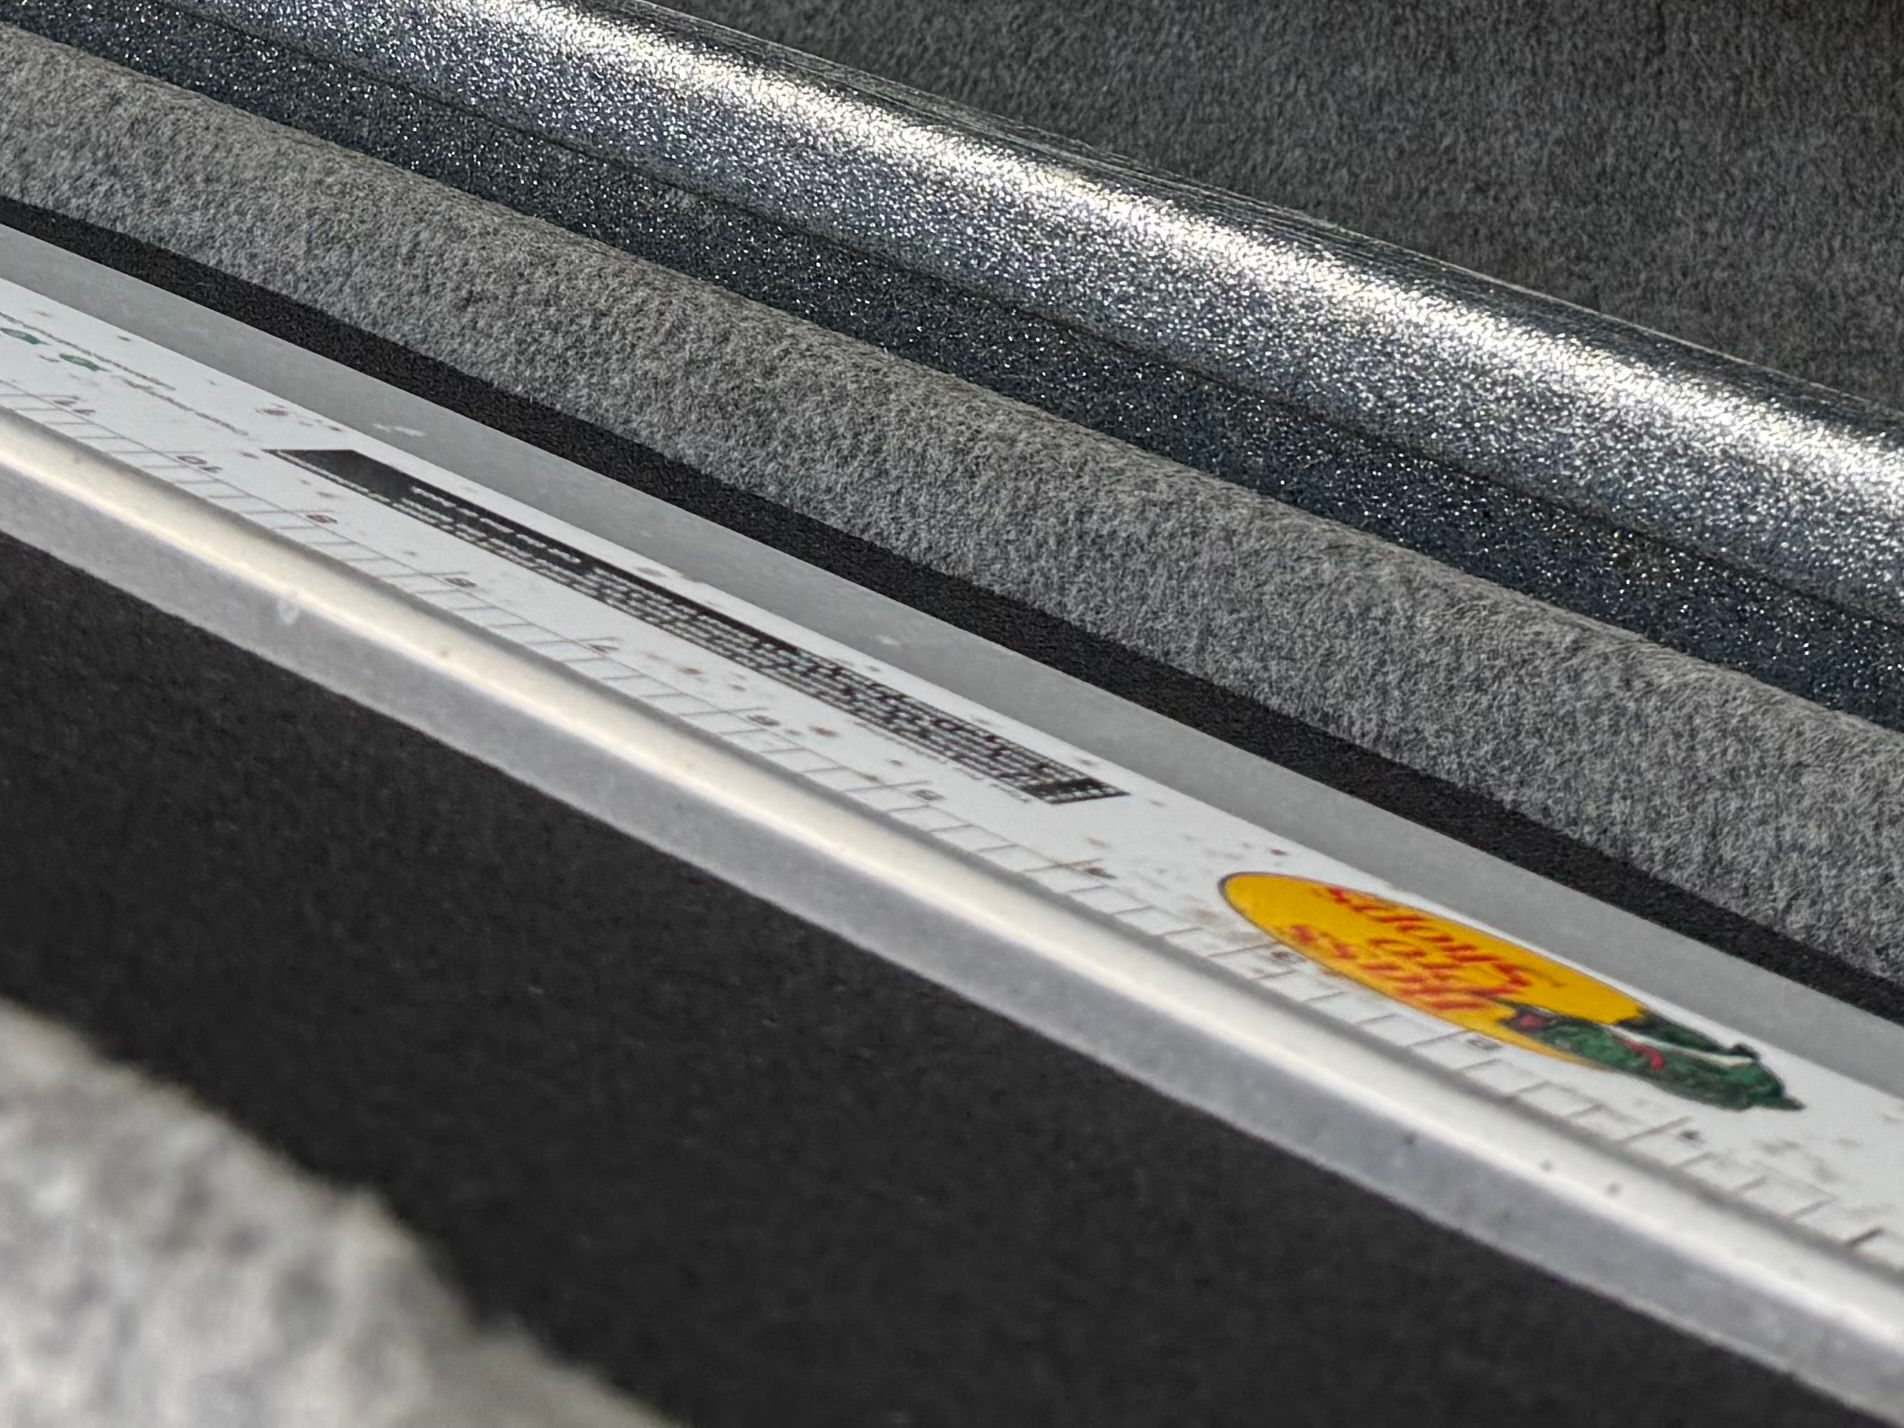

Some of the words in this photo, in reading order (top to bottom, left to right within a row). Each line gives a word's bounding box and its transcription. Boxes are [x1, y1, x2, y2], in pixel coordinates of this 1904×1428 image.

[1293, 923, 1490, 1012] Bass
[1326, 886, 1532, 987] Shops
[1368, 938, 1515, 998] Pro
